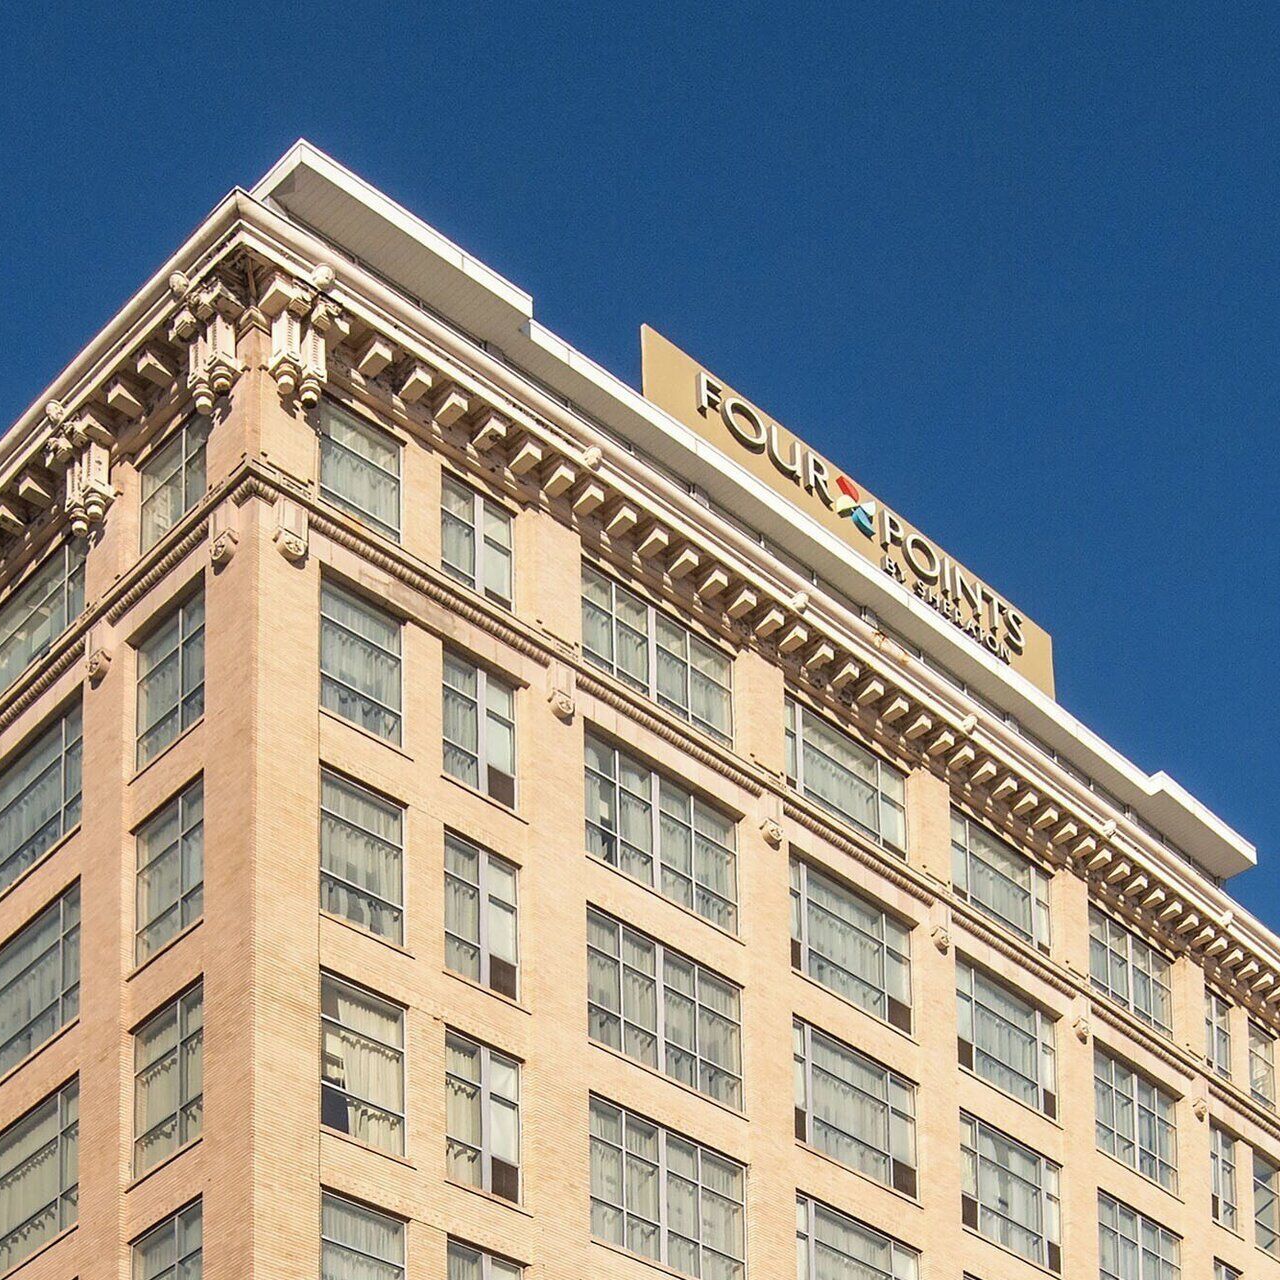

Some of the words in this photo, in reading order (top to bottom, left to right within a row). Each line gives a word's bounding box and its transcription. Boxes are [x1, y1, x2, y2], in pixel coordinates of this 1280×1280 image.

[696, 371, 835, 511] FOUR
[881, 509, 1026, 655] POINTS
[881, 554, 907, 583] BY
[913, 579, 1012, 665] SHERATON
